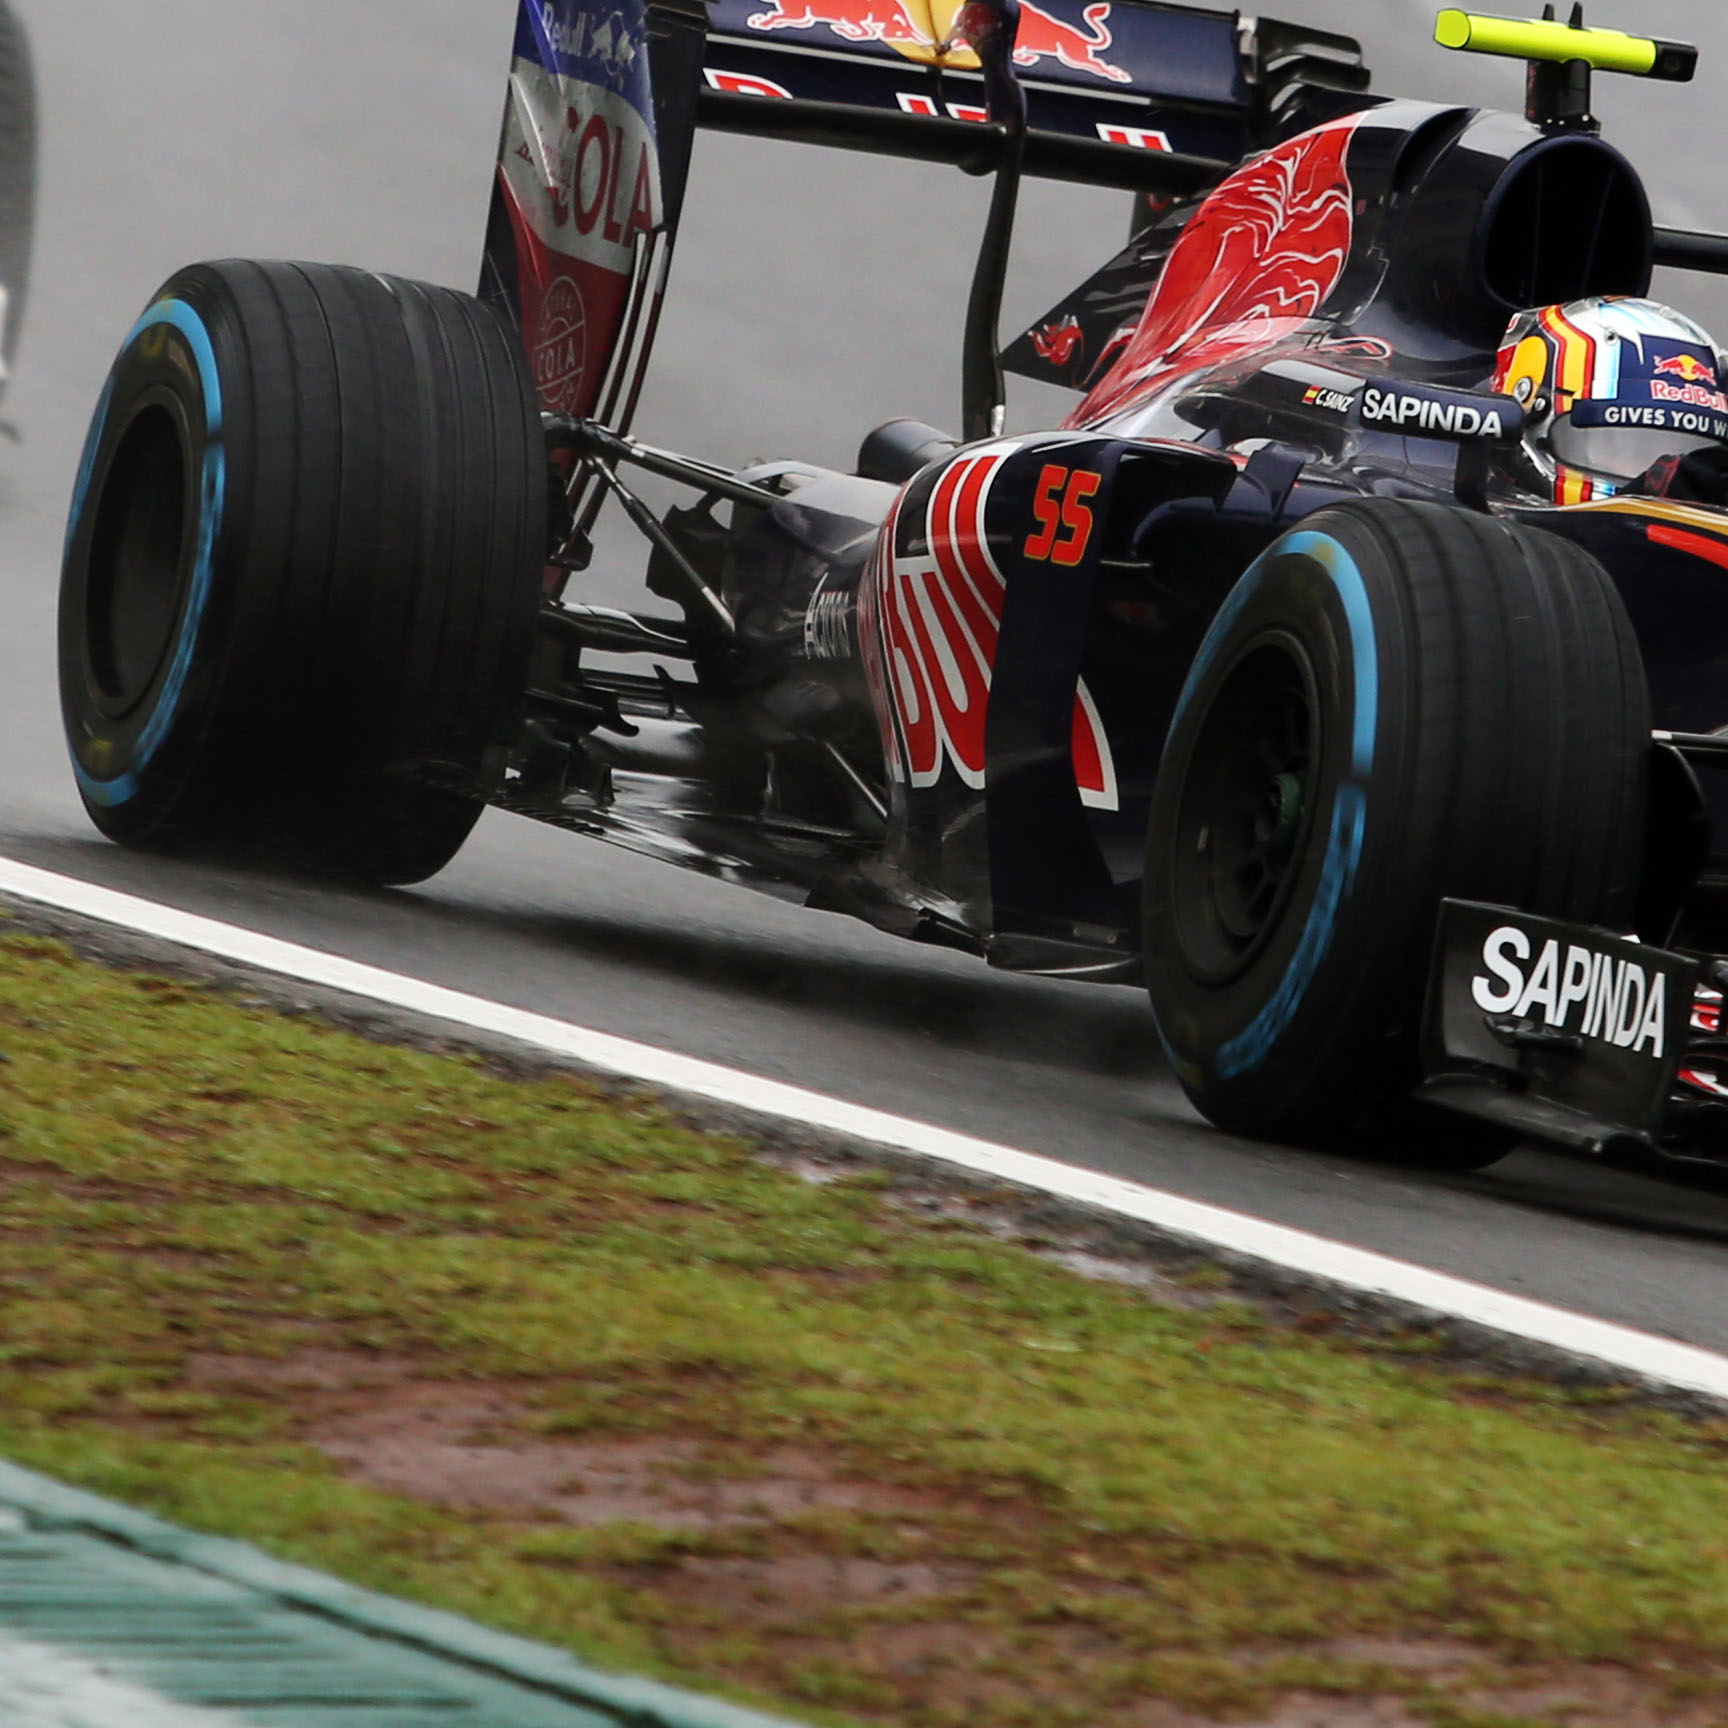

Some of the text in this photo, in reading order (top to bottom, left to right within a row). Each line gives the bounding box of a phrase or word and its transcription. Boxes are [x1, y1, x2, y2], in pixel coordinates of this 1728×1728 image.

[1362, 388, 1503, 439] SAPINDA
[1604, 405, 1666, 427] GIVES
[1671, 410, 1710, 432] YOU
[1024, 464, 1102, 567] 55
[1472, 926, 1666, 1059] SAPINDA
